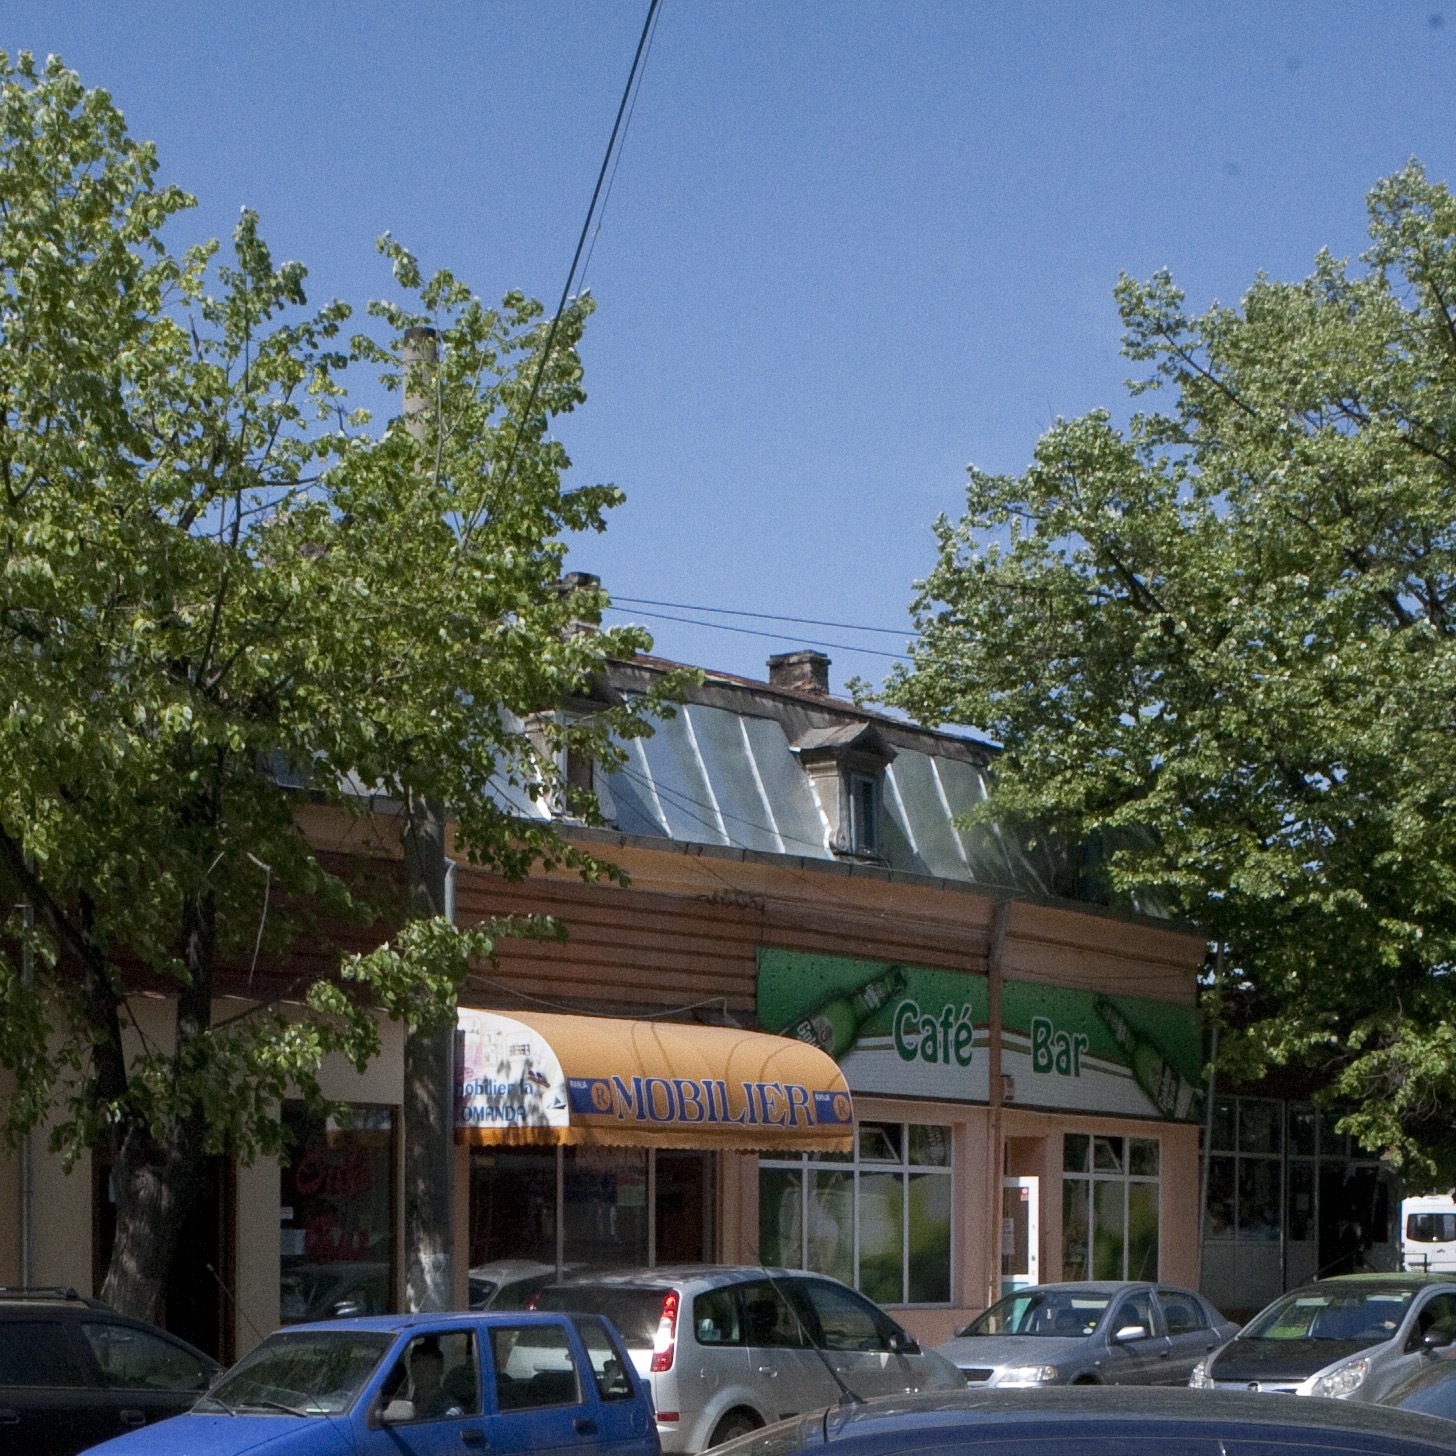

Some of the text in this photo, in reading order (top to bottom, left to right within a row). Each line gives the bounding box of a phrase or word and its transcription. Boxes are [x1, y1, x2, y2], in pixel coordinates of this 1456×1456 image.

[893, 998, 974, 1068] Café
[1030, 1015, 1090, 1078] Bar
[610, 1074, 816, 1128] MOBILIER
